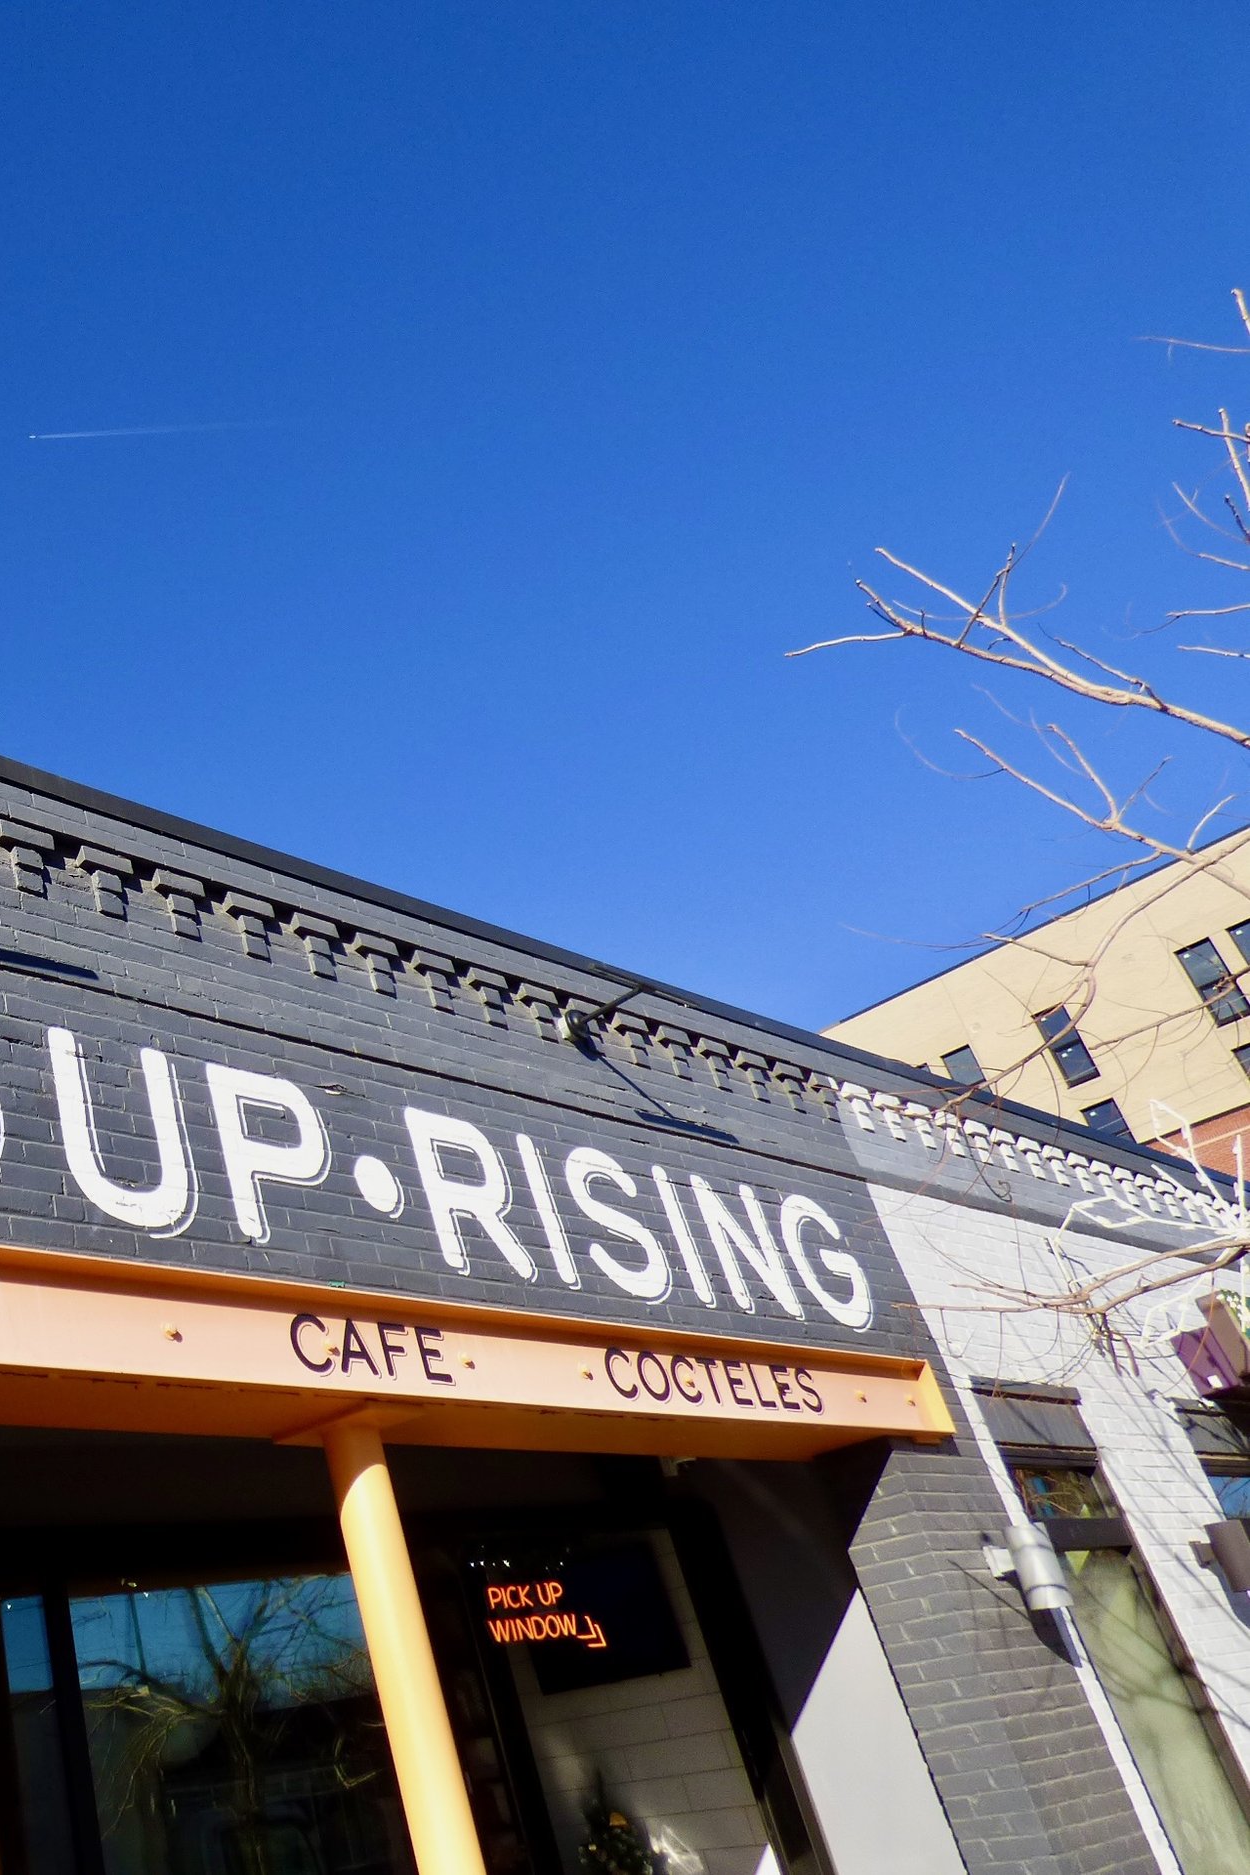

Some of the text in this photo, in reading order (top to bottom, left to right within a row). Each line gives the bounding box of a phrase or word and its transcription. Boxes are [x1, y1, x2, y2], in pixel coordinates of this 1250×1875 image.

[290, 1313, 456, 1386] CAFE
[604, 1346, 824, 1415] COCTELES
[488, 1581, 564, 1609] PICK UP
[488, 1613, 577, 1643] WINDOW
